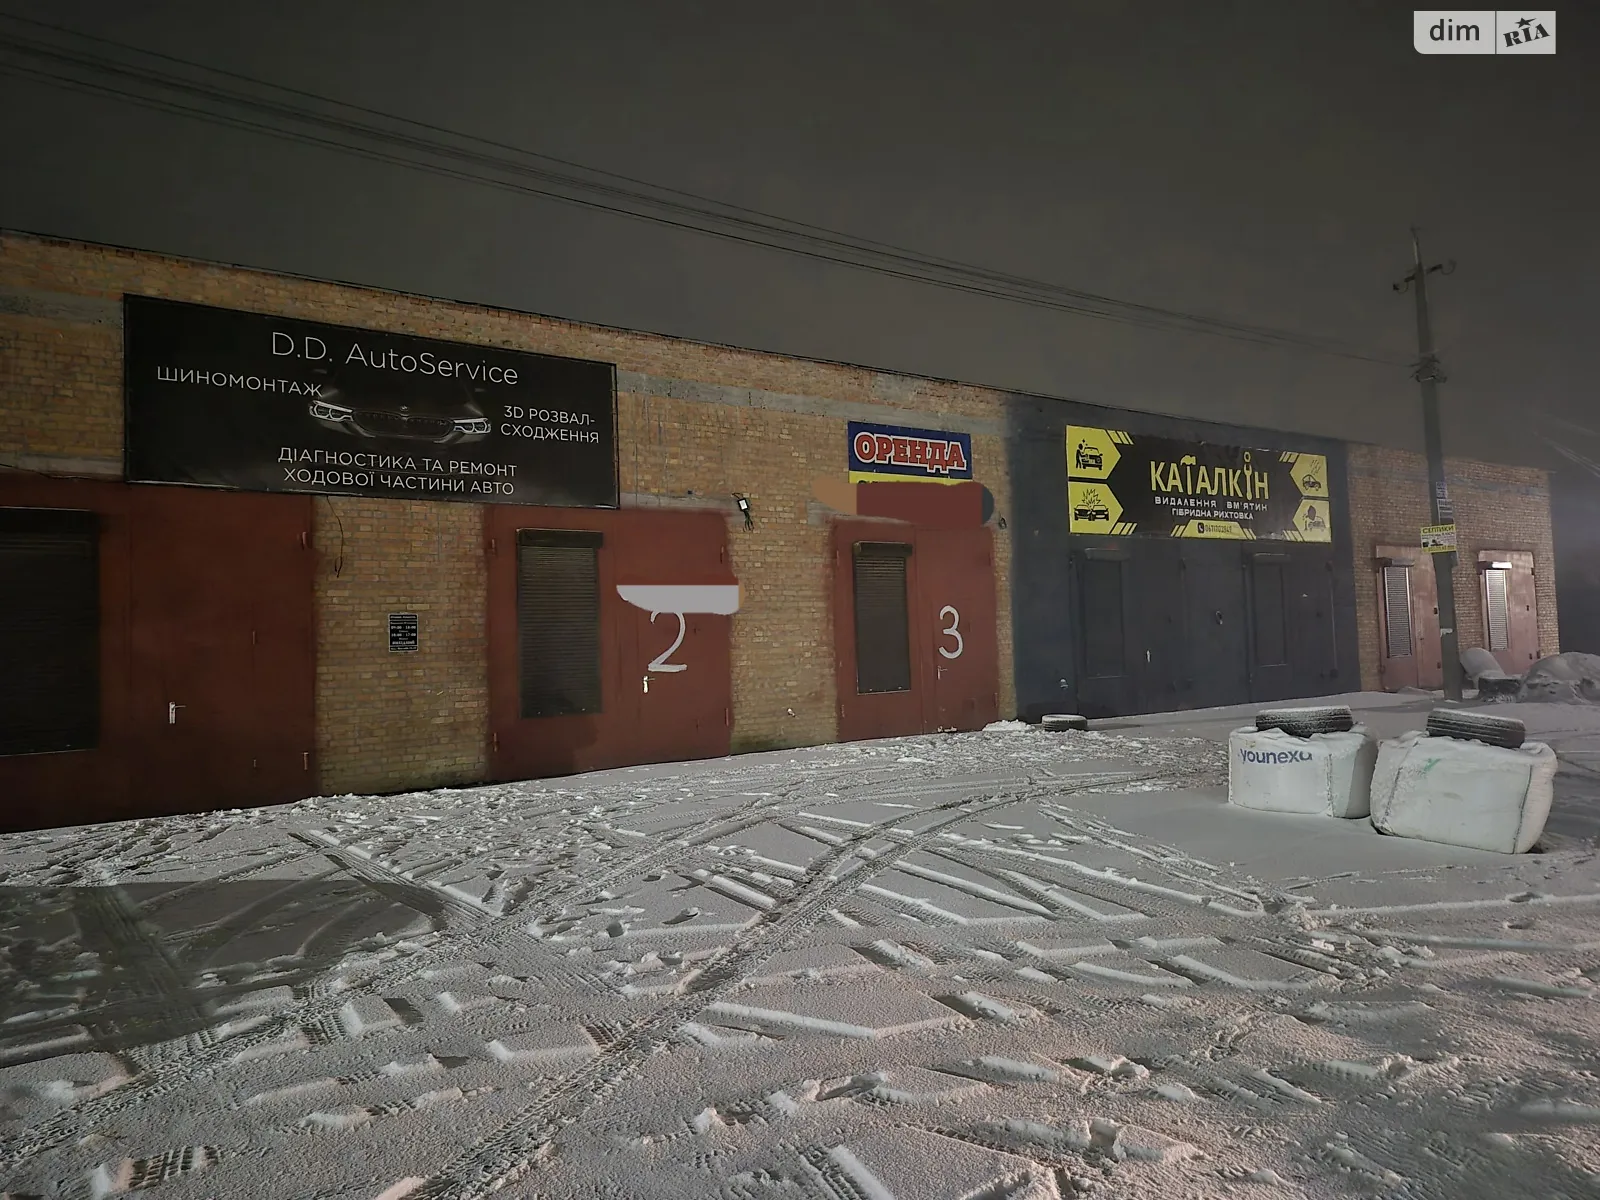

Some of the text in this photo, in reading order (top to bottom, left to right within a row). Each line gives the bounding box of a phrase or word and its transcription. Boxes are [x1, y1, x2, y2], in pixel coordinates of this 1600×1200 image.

[272, 331, 519, 385] D.D. AutoService
[157, 366, 323, 398] ШИНОМОНТАЖ
[503, 405, 595, 426] 3D РОЗВАЛ-
[500, 423, 600, 444] СХОДЖЕННЯ
[277, 447, 517, 477] ДІАГНОСТИКА ТА РЕМОНТ
[854, 431, 967, 474] ОРЕНДА
[284, 467, 515, 496] ХОДОВОЇ ЧАСТИНИ АВТО
[1154, 496, 1268, 512] ВИДАЛЕННЯ ВМ'ЯТИН
[1172, 507, 1254, 520] ГІБРИДНА РИХТОВКА
[647, 611, 688, 672] 2
[939, 605, 964, 660] 3
